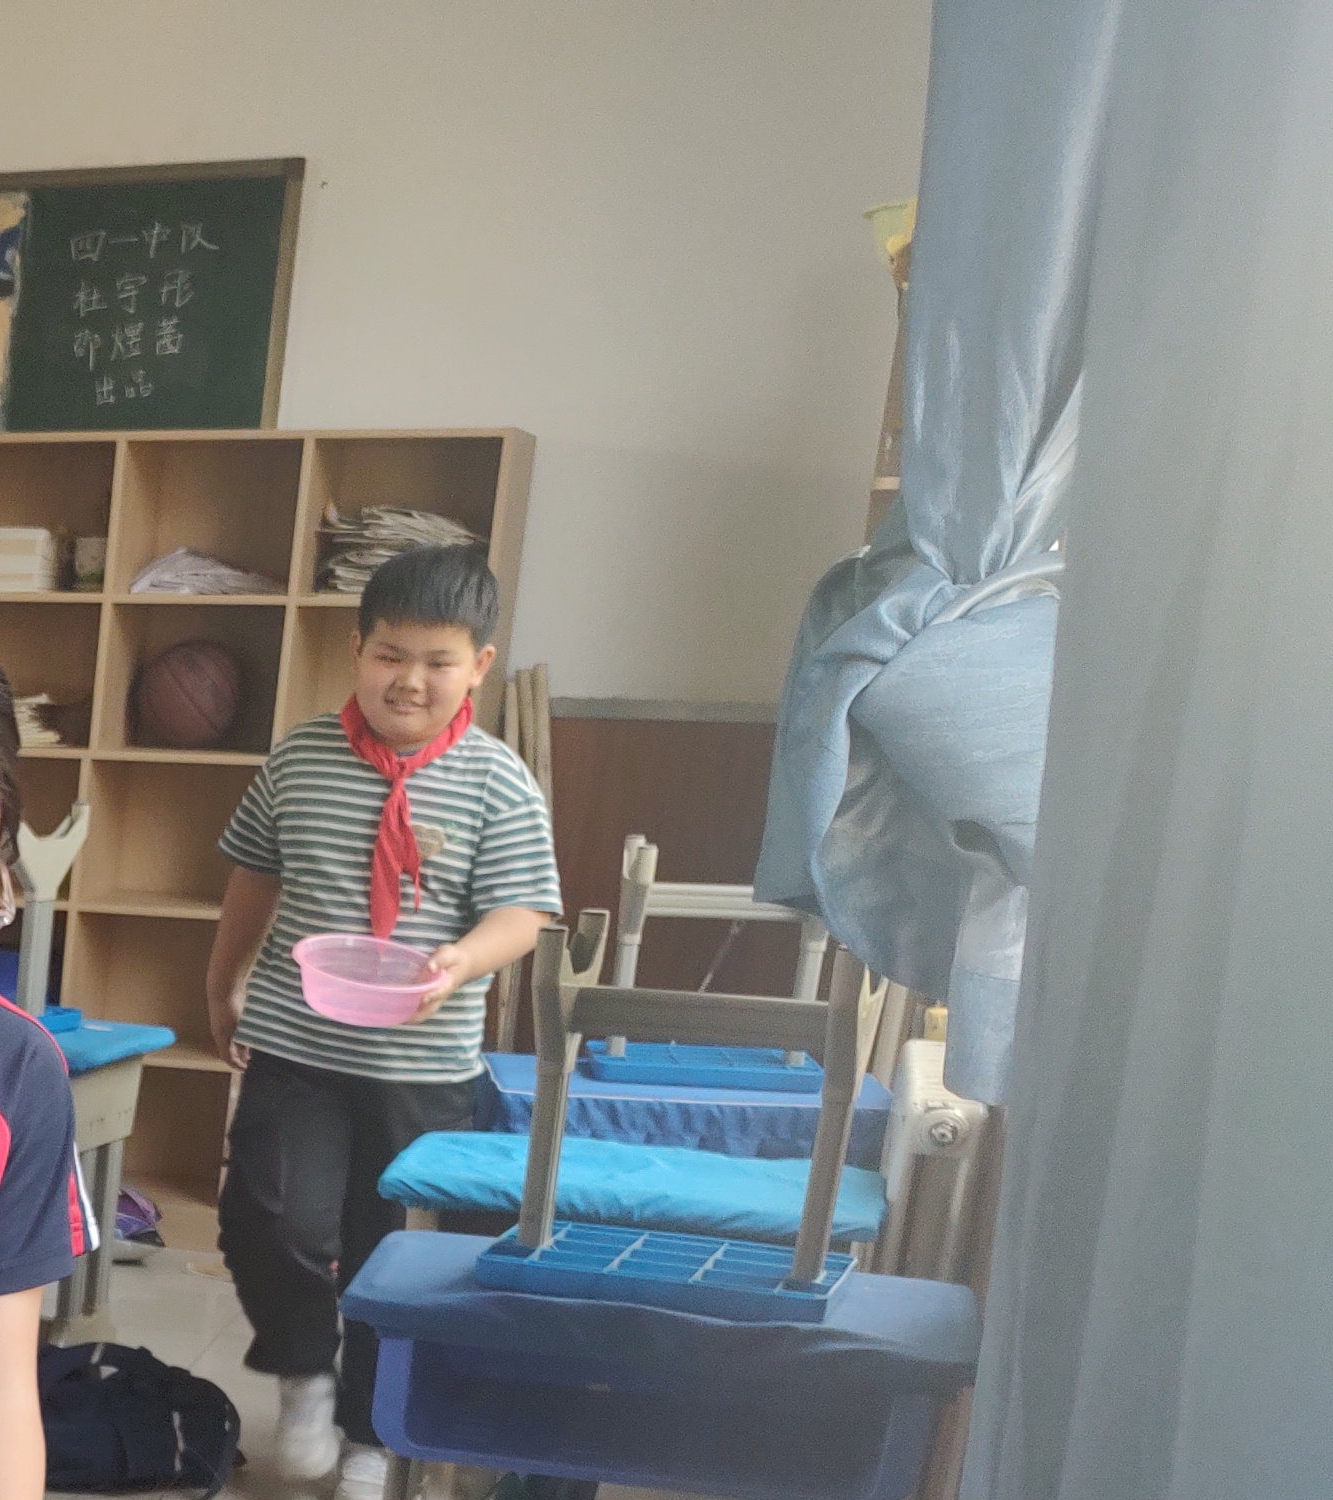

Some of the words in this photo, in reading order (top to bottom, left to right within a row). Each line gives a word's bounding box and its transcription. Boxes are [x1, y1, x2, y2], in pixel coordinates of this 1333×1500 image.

[70, 221, 220, 262] 四一中队
[95, 369, 154, 405] 出品
